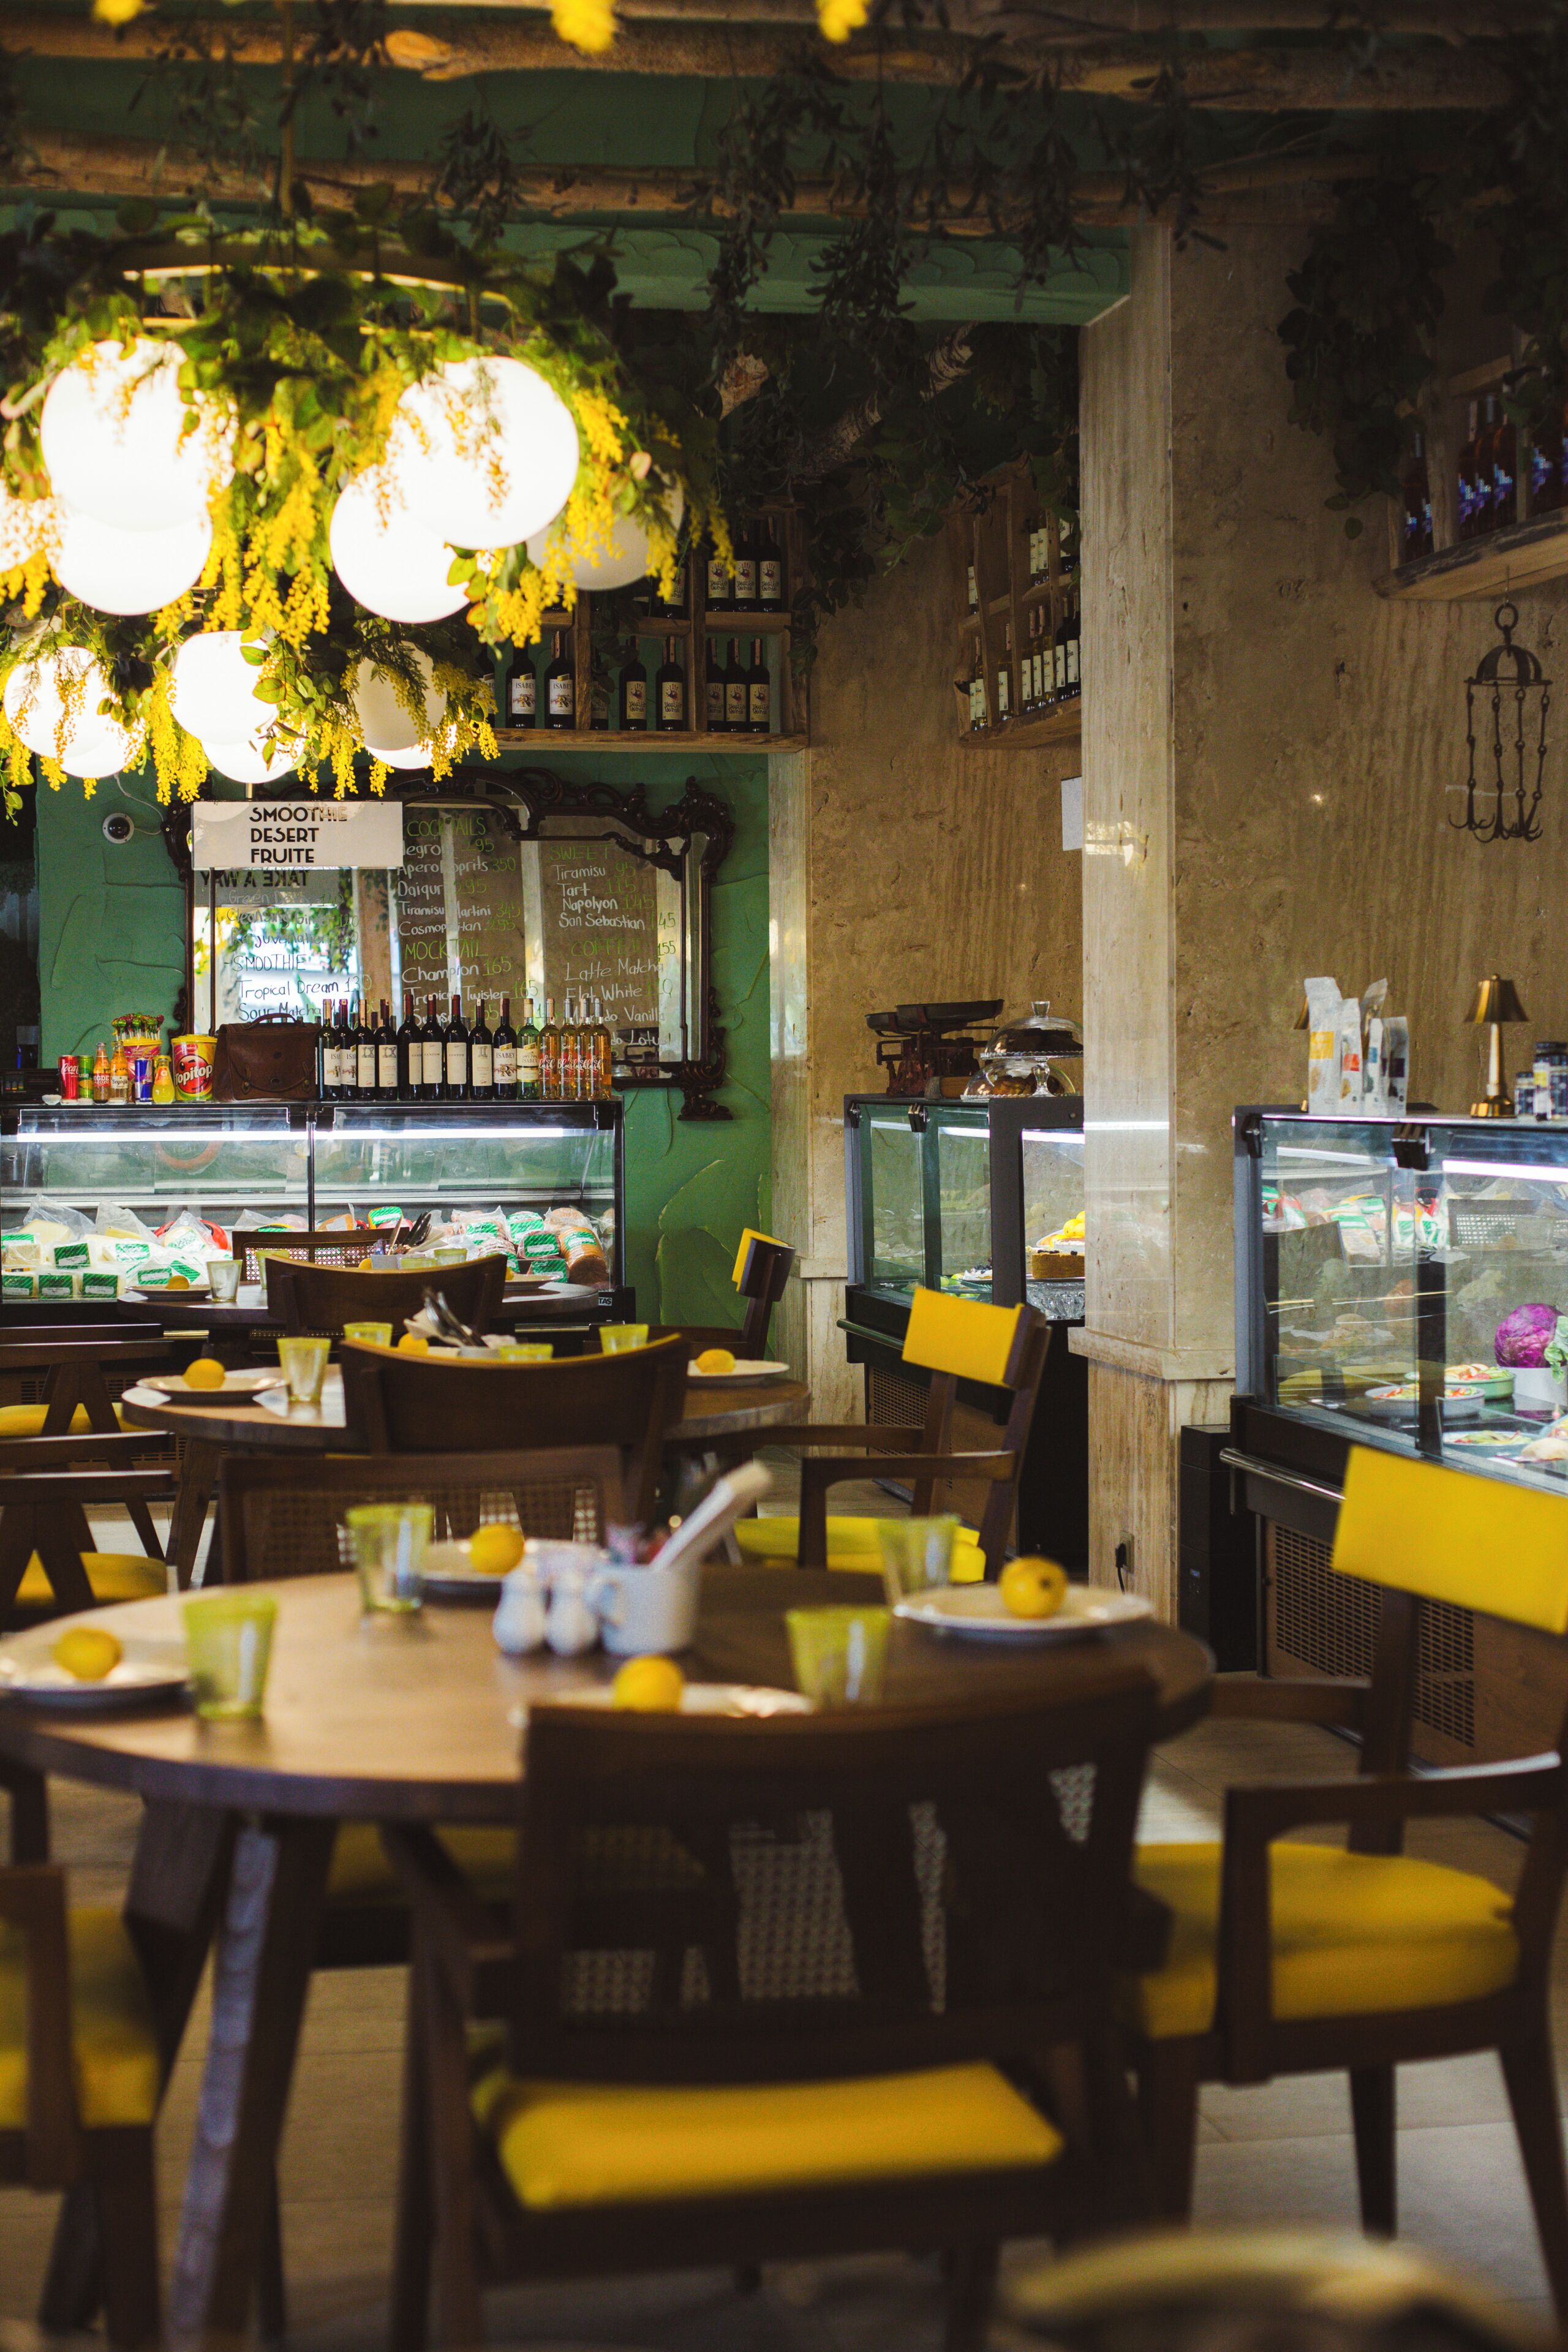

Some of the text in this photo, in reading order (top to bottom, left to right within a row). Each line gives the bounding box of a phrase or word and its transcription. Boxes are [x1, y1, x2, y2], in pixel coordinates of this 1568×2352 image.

[249, 807, 348, 823] SMOOTHIE
[251, 827, 320, 843] DESERT
[251, 848, 314, 864] FRUITE
[550, 843, 613, 860] SWEET
[551, 861, 636, 881] Tiramisu 95
[228, 890, 270, 905] Green
[556, 881, 590, 897] Tart
[398, 900, 445, 916] Tiramisu
[562, 895, 618, 914] Napolyon
[558, 911, 582, 929] San
[584, 913, 646, 931] Sebastian
[571, 937, 644, 957] COFFEE
[401, 956, 512, 983] Champion 165
[564, 957, 665, 982] Latte Matcha
[235, 980, 290, 1001] Tropical
[296, 980, 339, 995] Dream
[462, 984, 511, 1001] Twister
[600, 982, 643, 1001] White
[238, 1002, 275, 1023] Sour
[279, 1001, 323, 1019] Matcha
[175, 1065, 213, 1086] Topitop
